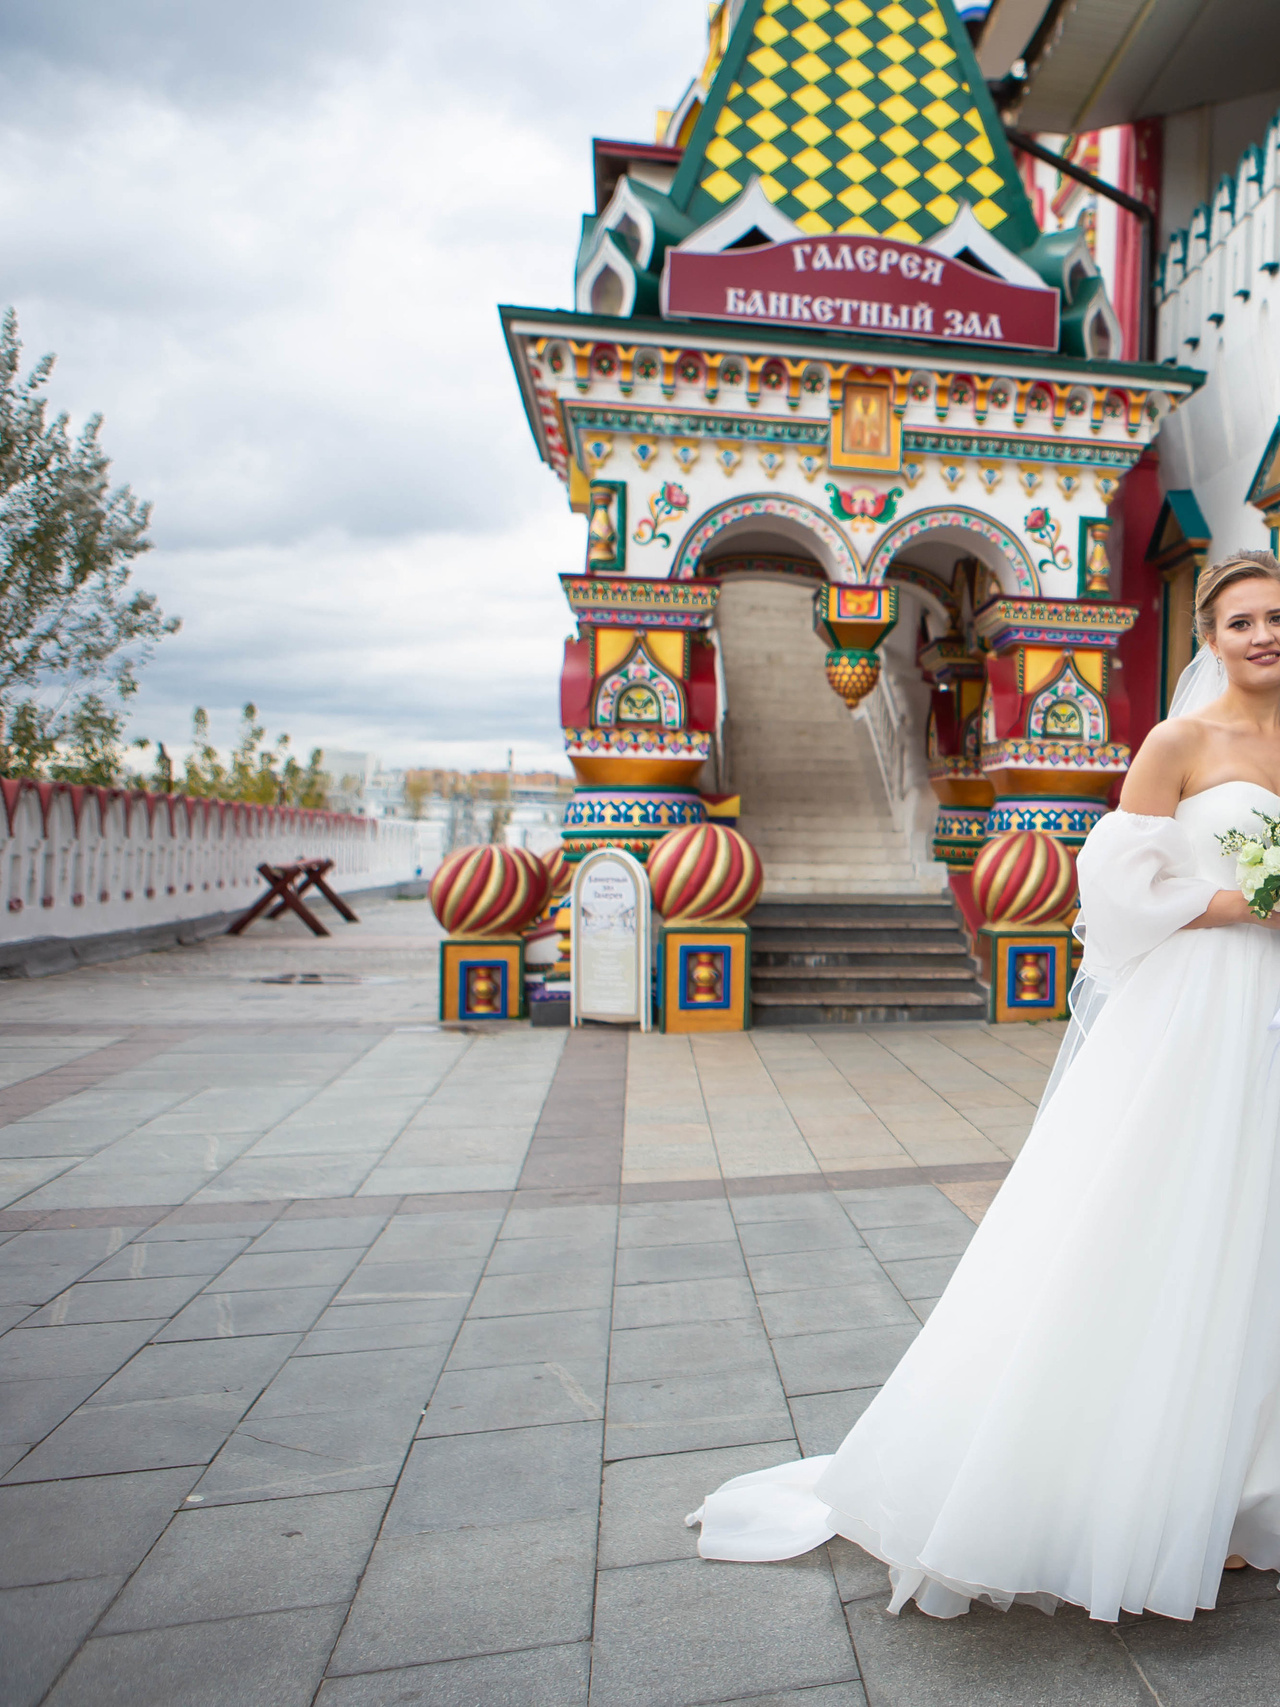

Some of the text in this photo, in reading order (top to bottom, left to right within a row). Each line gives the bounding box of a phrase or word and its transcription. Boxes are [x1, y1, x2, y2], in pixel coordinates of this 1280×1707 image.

[792, 243, 945, 286] ГАЛЕРЕЯ
[725, 287, 1004, 339] БАНКЕТНЫЙ ЗАЛ
